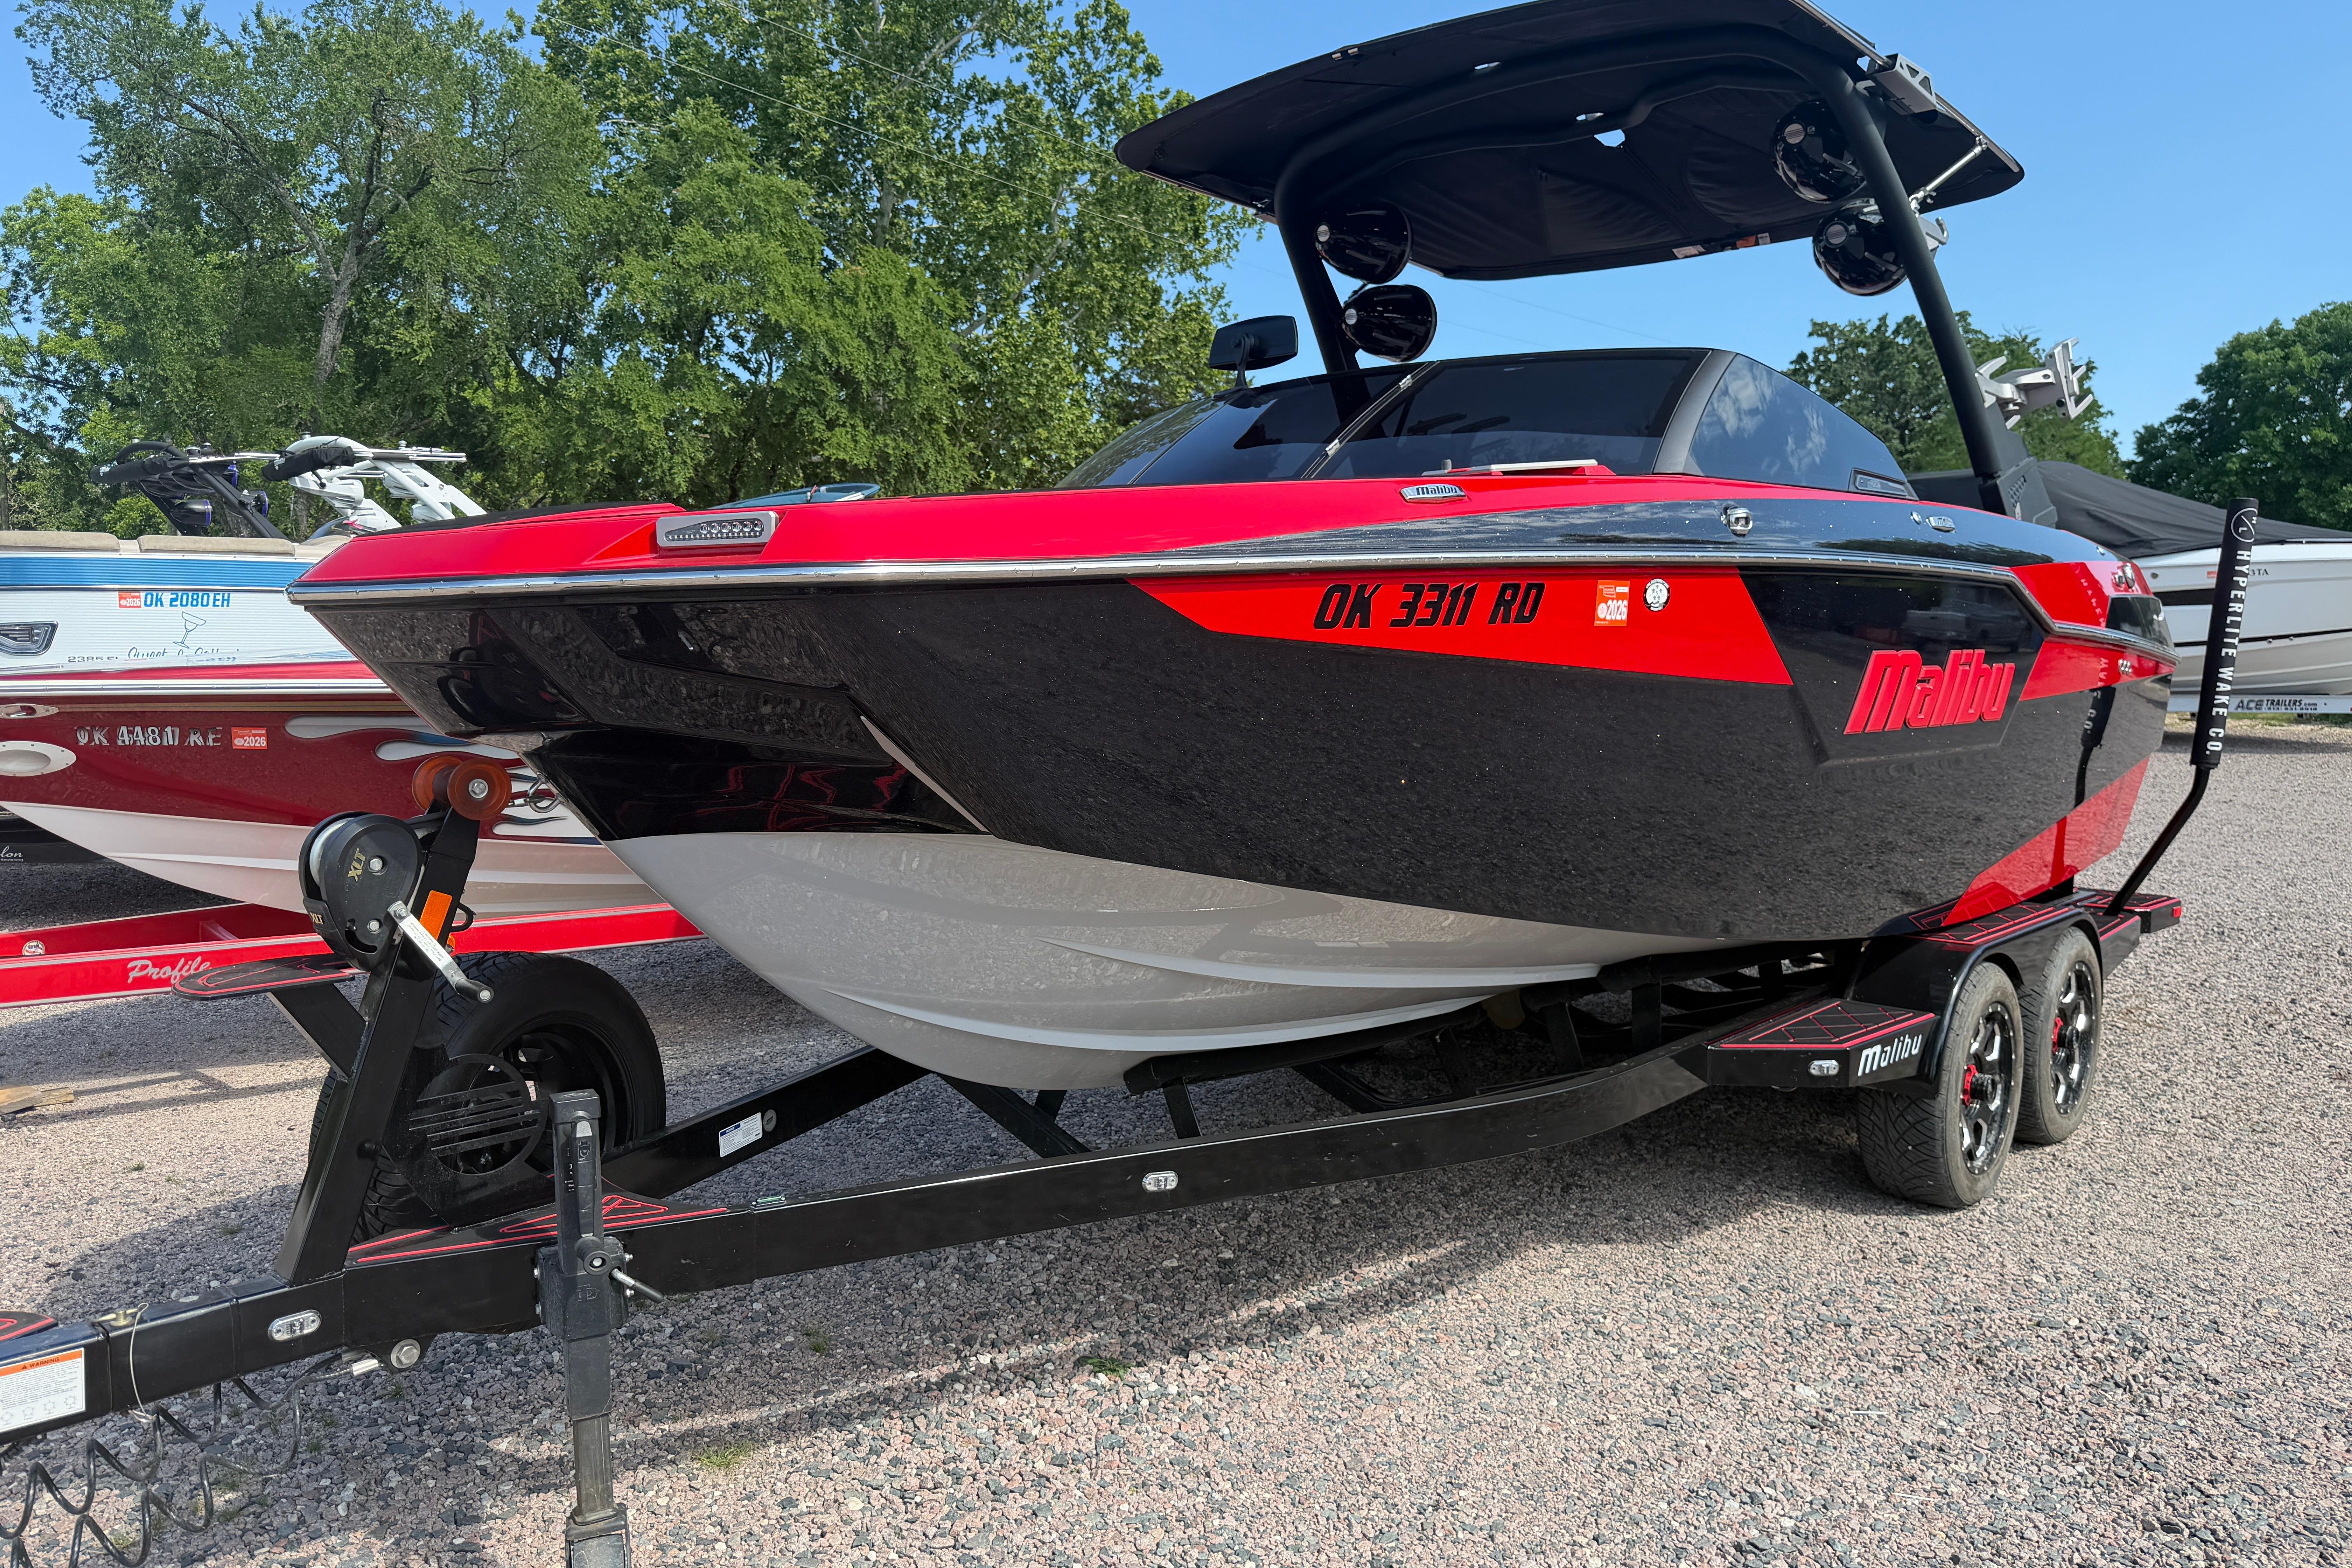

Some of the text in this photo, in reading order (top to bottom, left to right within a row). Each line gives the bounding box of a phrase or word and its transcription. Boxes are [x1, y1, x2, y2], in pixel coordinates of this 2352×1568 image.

[1416, 485, 1457, 495] Malibu
[144, 592, 231, 607] OK 2080 EH
[1313, 581, 1546, 630] OK 3311 RD
[1605, 599, 1628, 620] 2026
[2205, 550, 2251, 755] HYPERLITE WAKE CO.
[1843, 649, 2016, 735] Malibu
[2234, 699, 2264, 710] ACE
[76, 726, 110, 745] OK
[244, 736, 266, 747] 2026
[0, 846, 23, 857] lon
[348, 848, 366, 882] XLT
[127, 956, 210, 984] Profile
[1857, 1034, 1923, 1077] Malibu
[29, 1357, 60, 1368] WARNING
